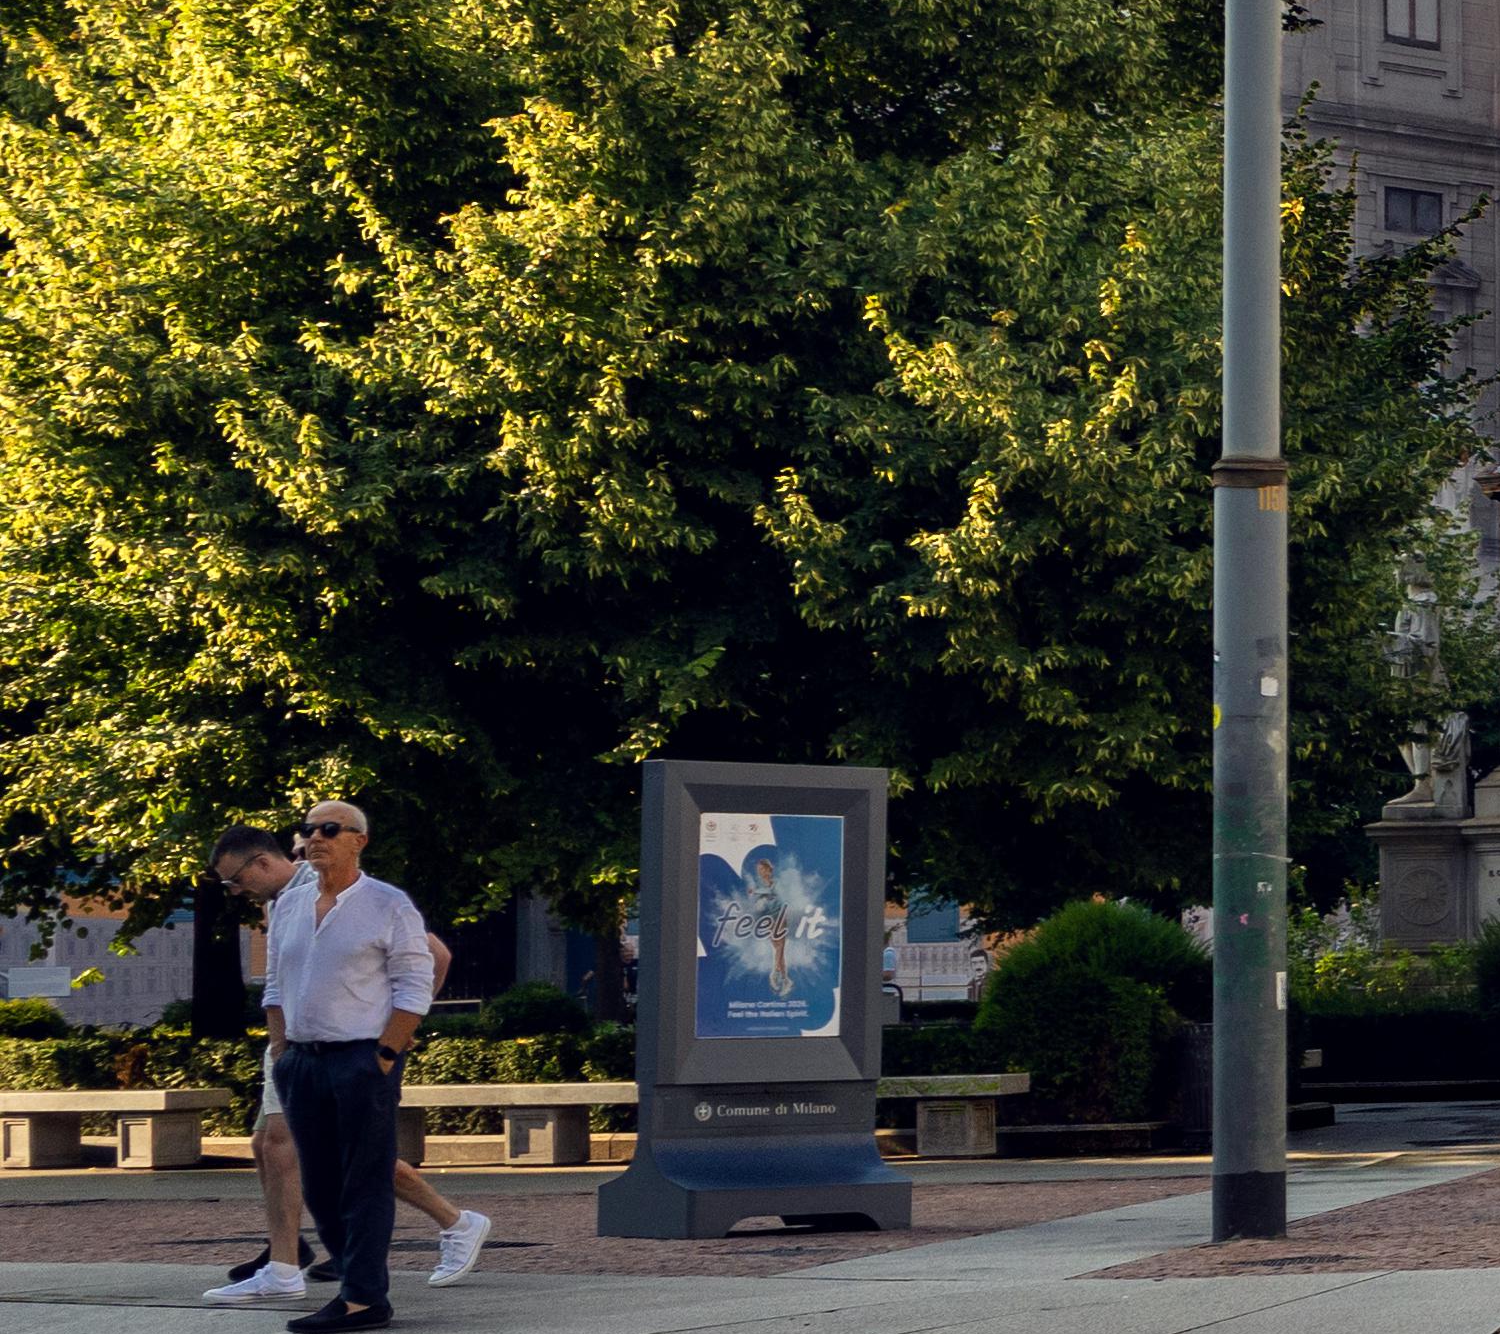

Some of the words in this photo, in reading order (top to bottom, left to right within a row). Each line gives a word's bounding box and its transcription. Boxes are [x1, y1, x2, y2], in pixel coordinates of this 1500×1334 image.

[712, 901, 788, 947] feel
[795, 904, 826, 939] it
[717, 1105, 770, 1116] Comune
[775, 1103, 787, 1115] di
[792, 1102, 836, 1115] Milano
